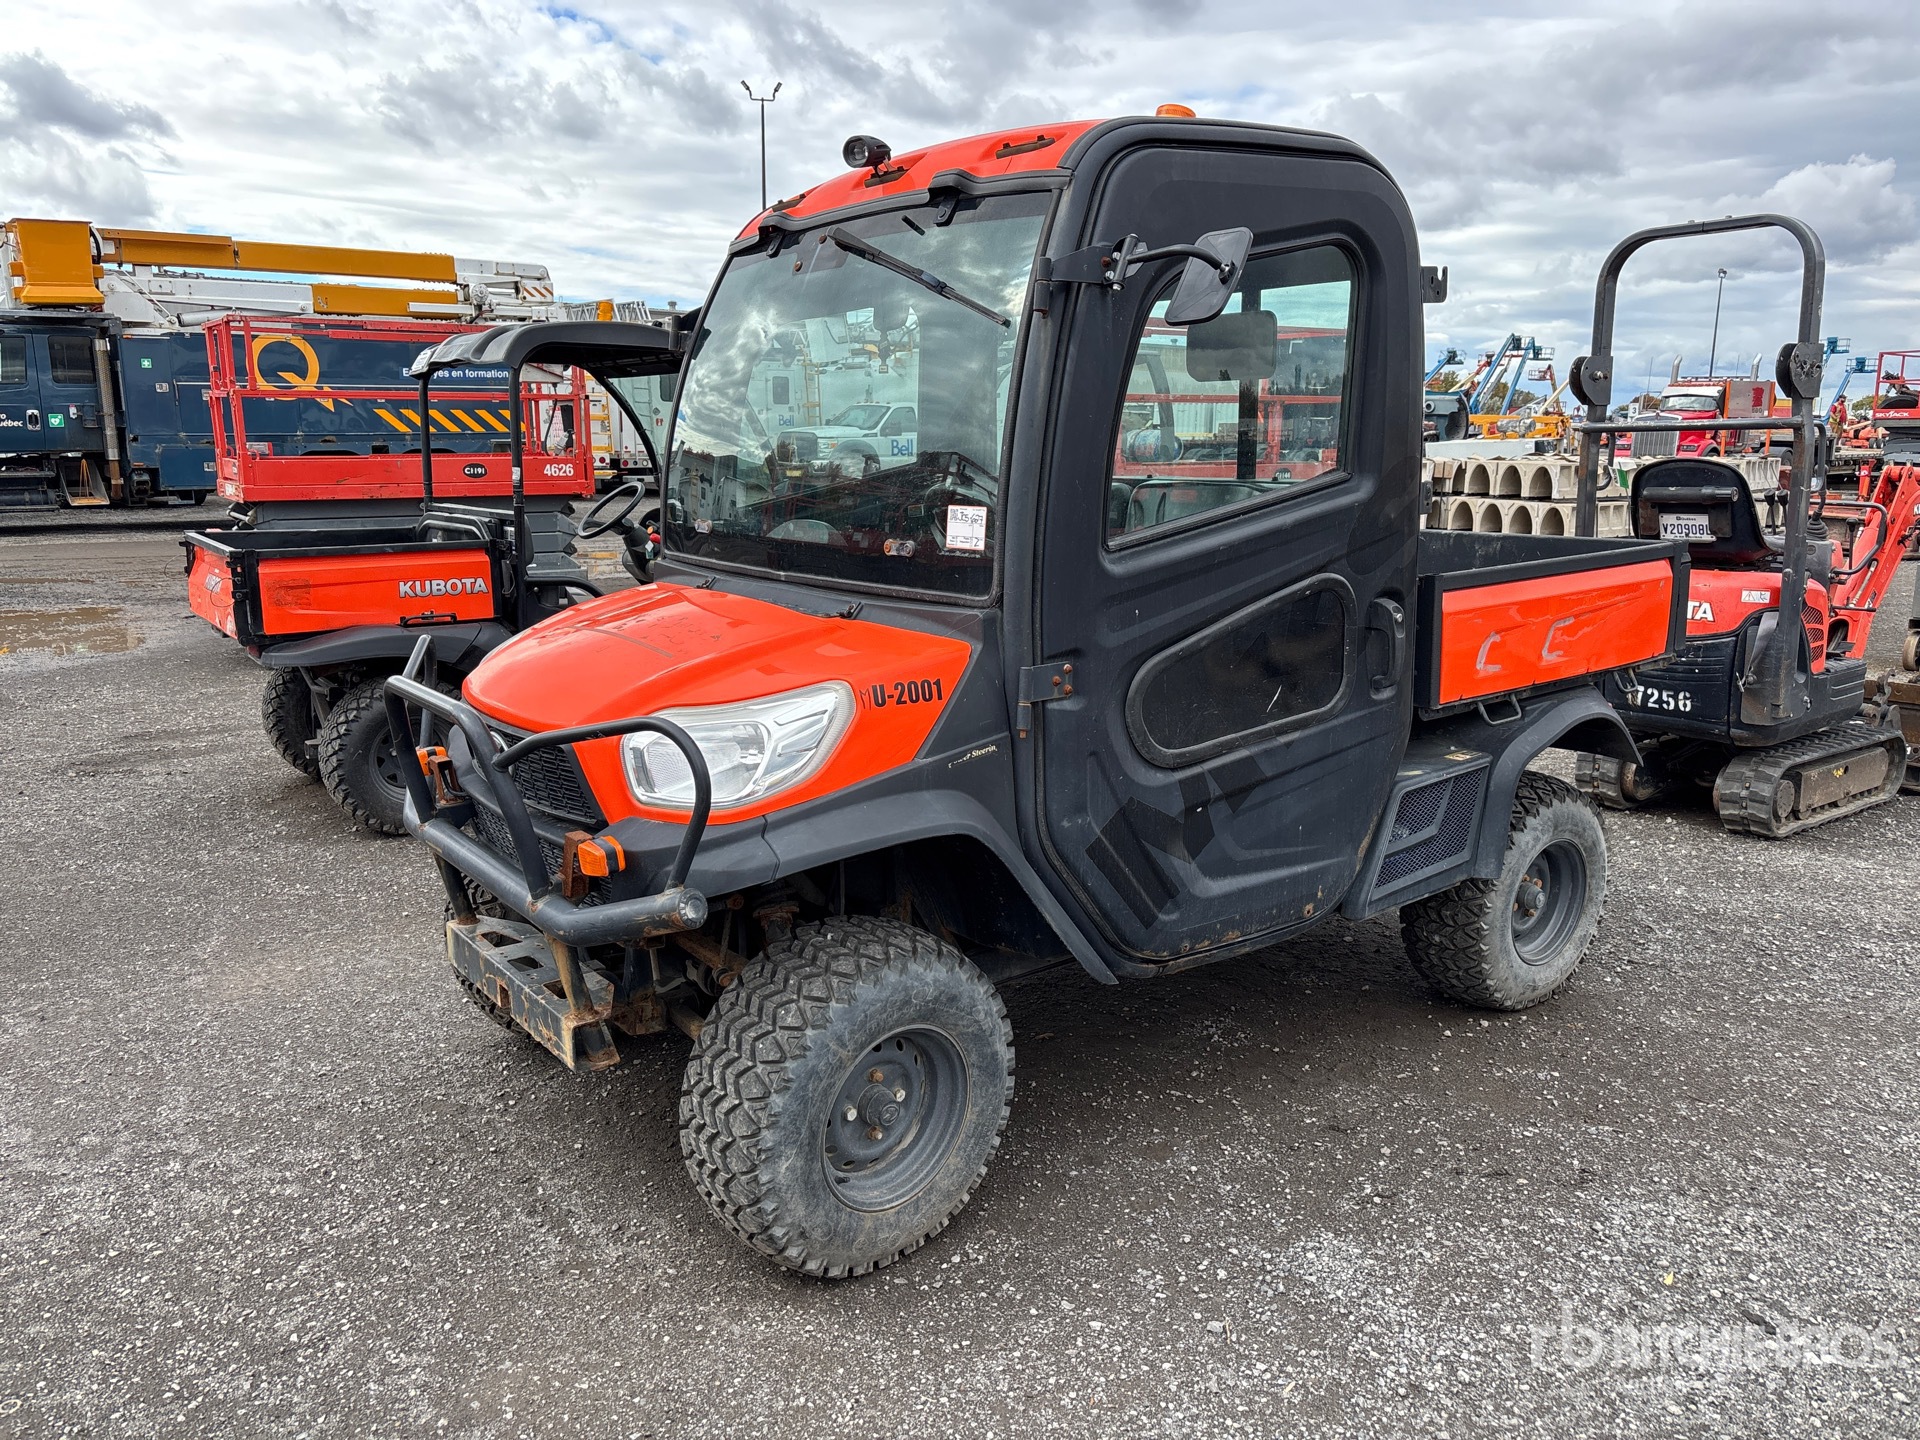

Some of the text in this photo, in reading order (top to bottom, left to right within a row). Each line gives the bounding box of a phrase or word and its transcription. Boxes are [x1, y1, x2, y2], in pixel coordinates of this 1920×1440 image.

[452, 370, 463, 378] en
[466, 369, 509, 378] formation
[1875, 410, 1910, 418] SKYJACK
[778, 415, 795, 427] Bell
[891, 440, 913, 457] Bell
[544, 464, 574, 476] 4626
[399, 577, 489, 598] KUBOTA
[971, 744, 998, 758] Steerin
